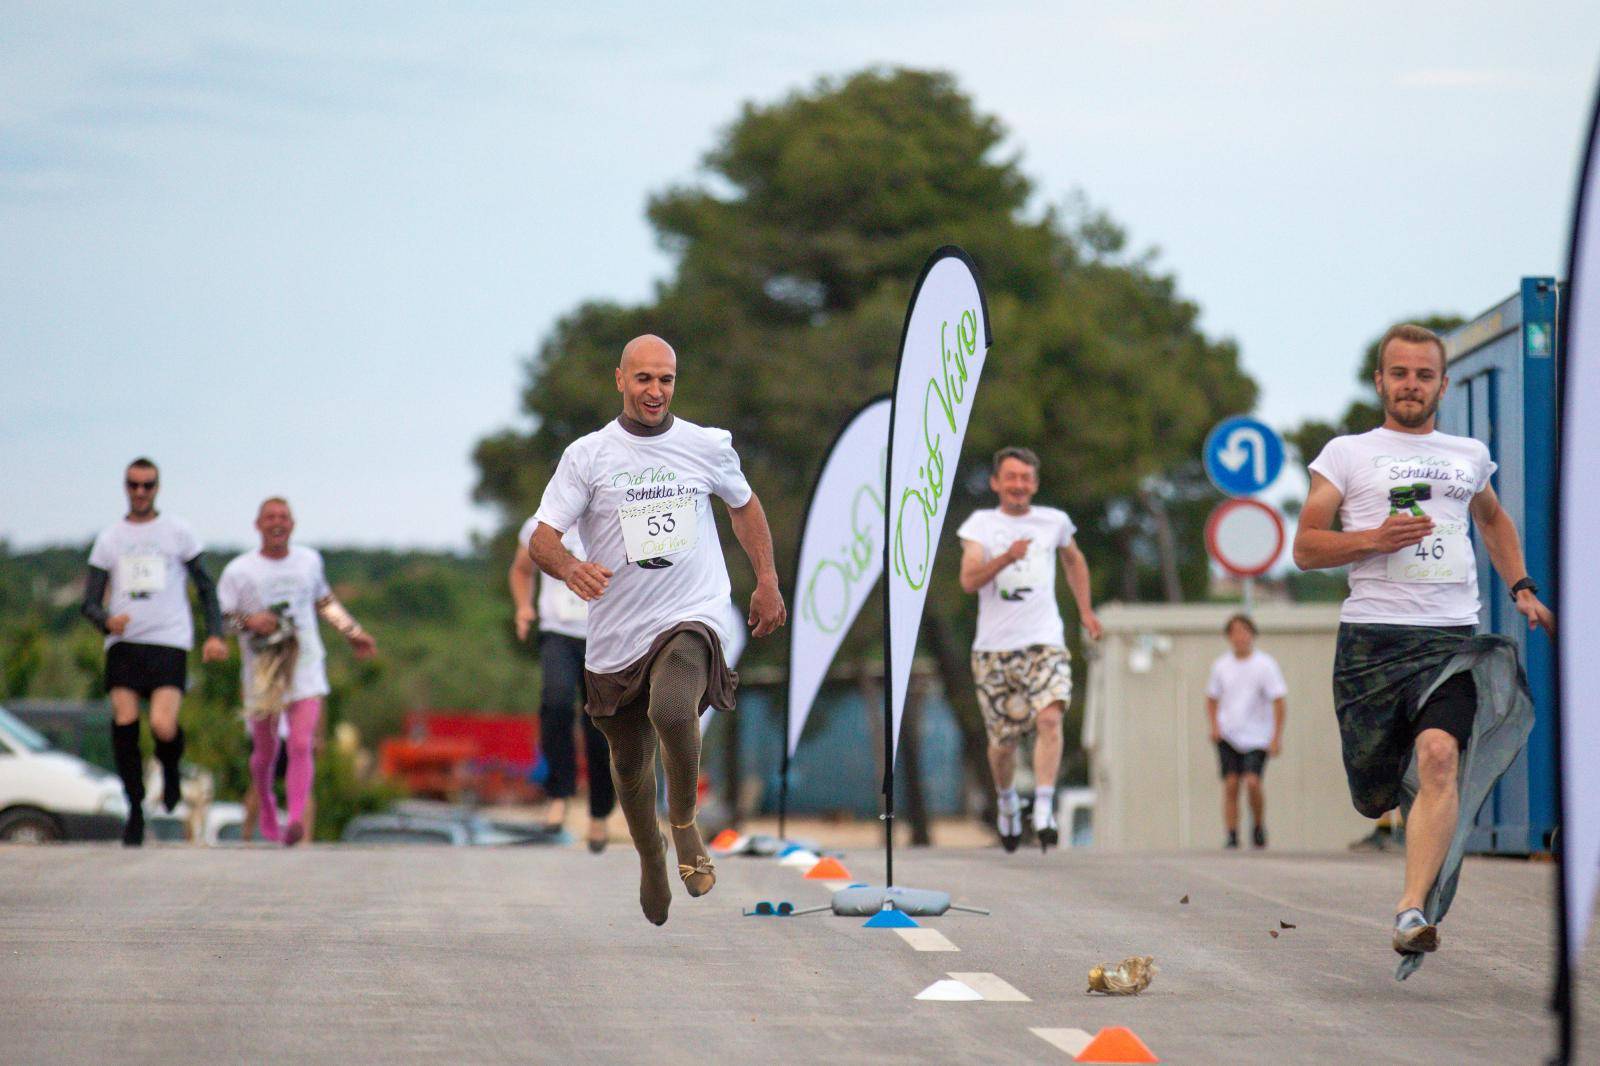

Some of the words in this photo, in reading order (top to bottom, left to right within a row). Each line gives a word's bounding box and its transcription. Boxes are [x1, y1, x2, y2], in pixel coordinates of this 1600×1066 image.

[924, 308, 977, 448] Vivo
[641, 465, 677, 484] Vivo
[625, 484, 675, 502] Schtikla
[677, 484, 698, 497] Run
[647, 512, 676, 536] 53
[1414, 537, 1445, 561] 46
